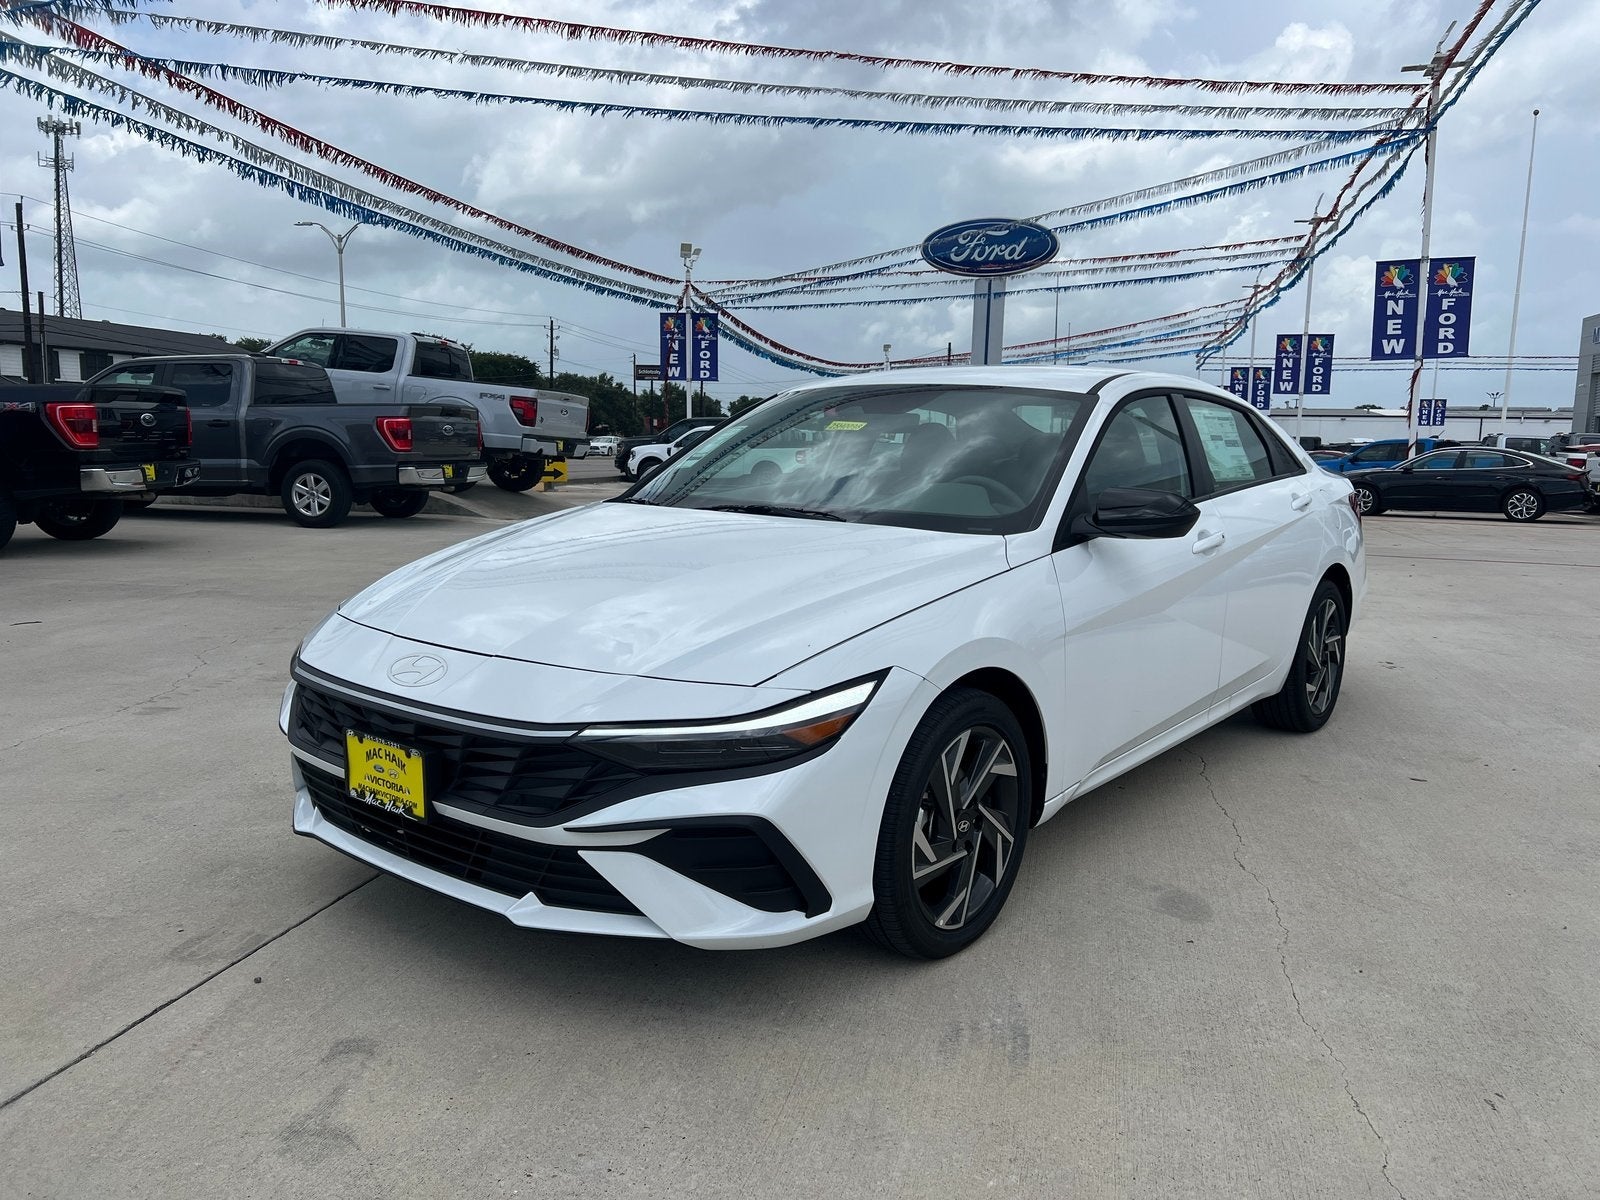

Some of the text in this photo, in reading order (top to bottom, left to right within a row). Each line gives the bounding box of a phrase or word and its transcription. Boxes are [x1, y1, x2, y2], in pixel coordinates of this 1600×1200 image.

[950, 229, 1028, 262] Ford
[1381, 299, 1406, 355] NEW
[1437, 298, 1457, 354] FORD
[667, 340, 681, 377] NEW
[699, 340, 711, 378] FORD
[1279, 358, 1294, 392] NEW
[1311, 358, 1324, 392] FORD
[479, 392, 506, 401] FX4
[1256, 384, 1265, 409] FORD
[1420, 409, 1428, 425] NEW
[366, 748, 407, 775] MAC HAIK
[369, 774, 405, 794] VICTORIA
[364, 793, 406, 816] Mac Haik
